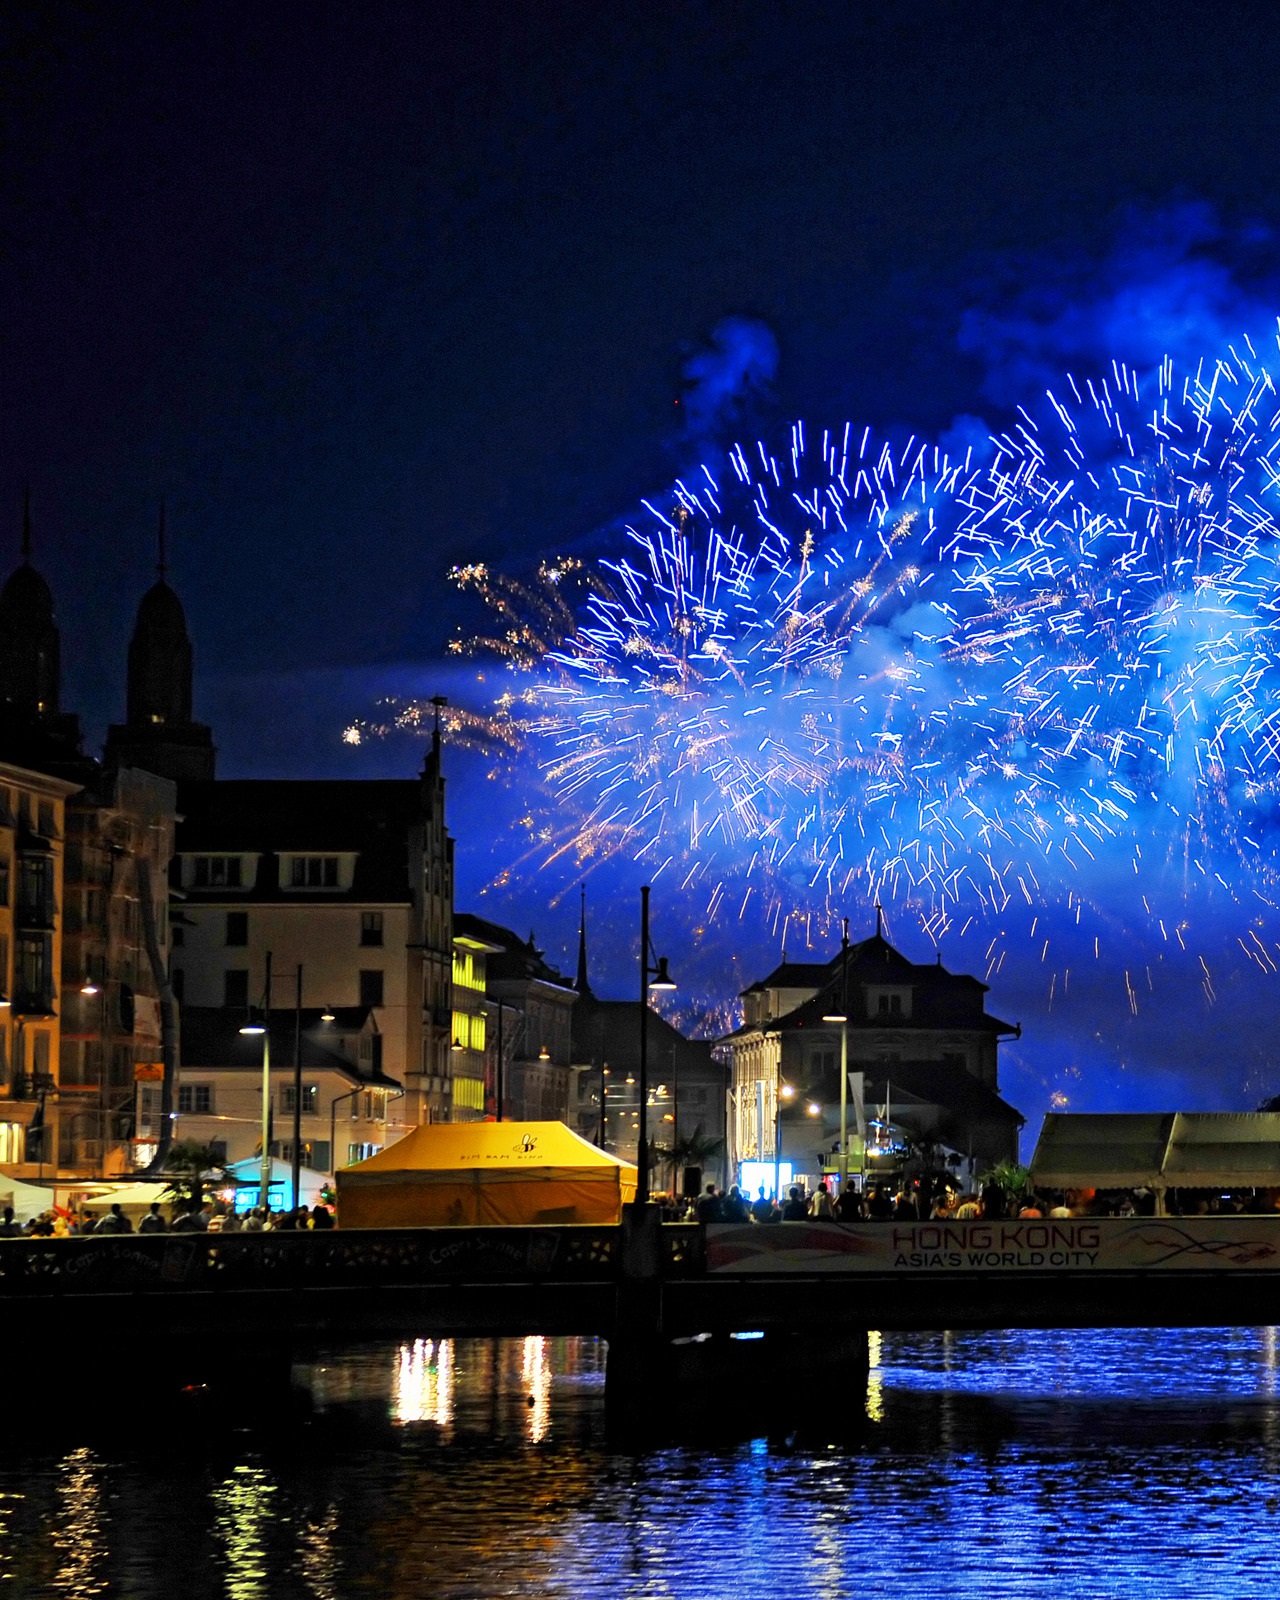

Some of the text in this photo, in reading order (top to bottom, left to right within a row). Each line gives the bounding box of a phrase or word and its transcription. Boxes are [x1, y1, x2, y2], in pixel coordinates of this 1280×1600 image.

[893, 1226, 1100, 1250] HONG KONG
[894, 1251, 1099, 1267] ASIA'S WORLD CITY
